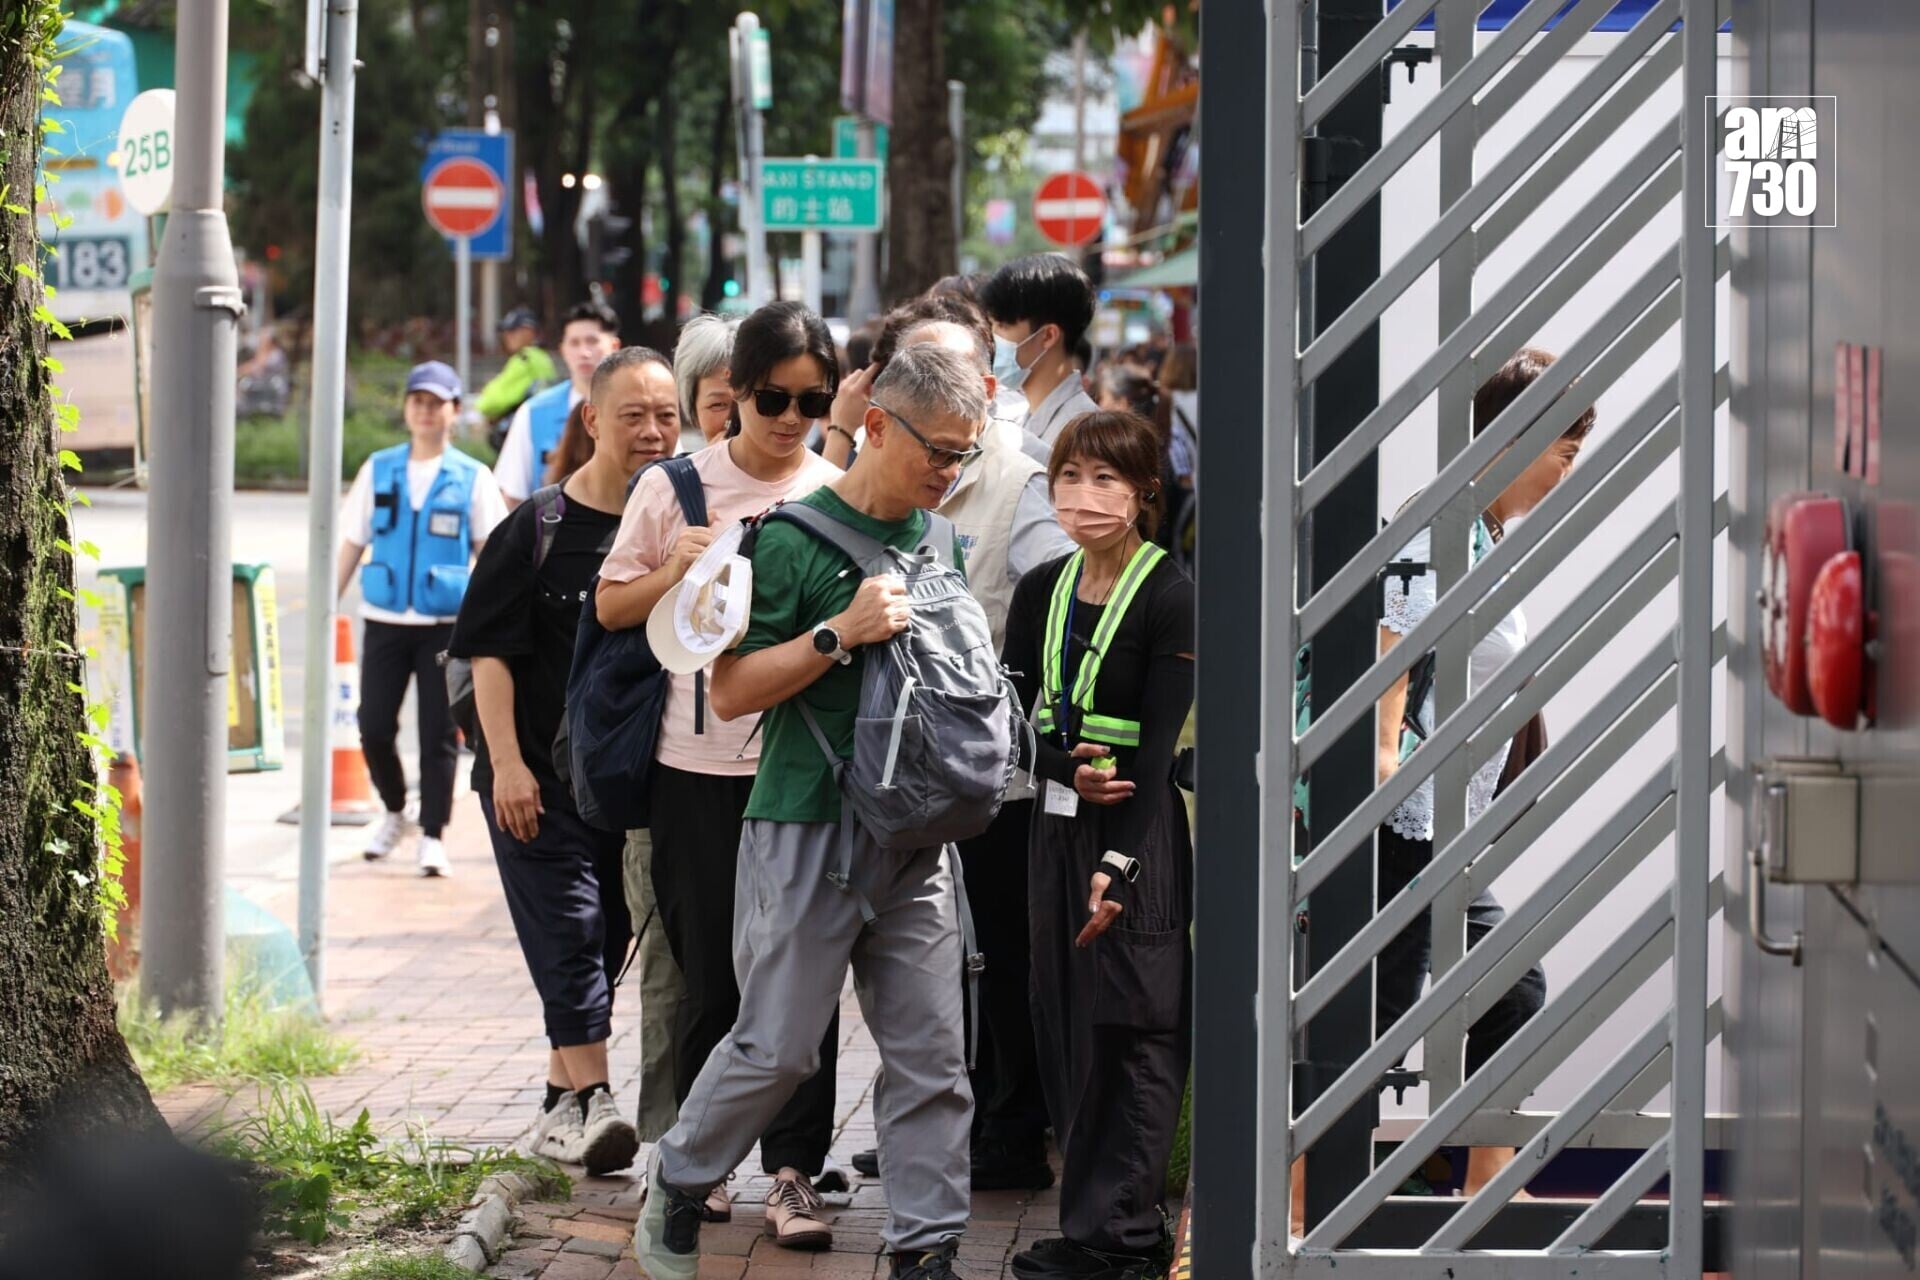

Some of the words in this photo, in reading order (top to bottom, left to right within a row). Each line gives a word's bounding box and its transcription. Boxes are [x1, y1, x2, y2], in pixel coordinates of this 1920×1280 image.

[124, 130, 171, 177] 25B
[761, 171, 798, 189] AXI
[802, 171, 873, 191] STAND
[56, 241, 126, 288] 183
